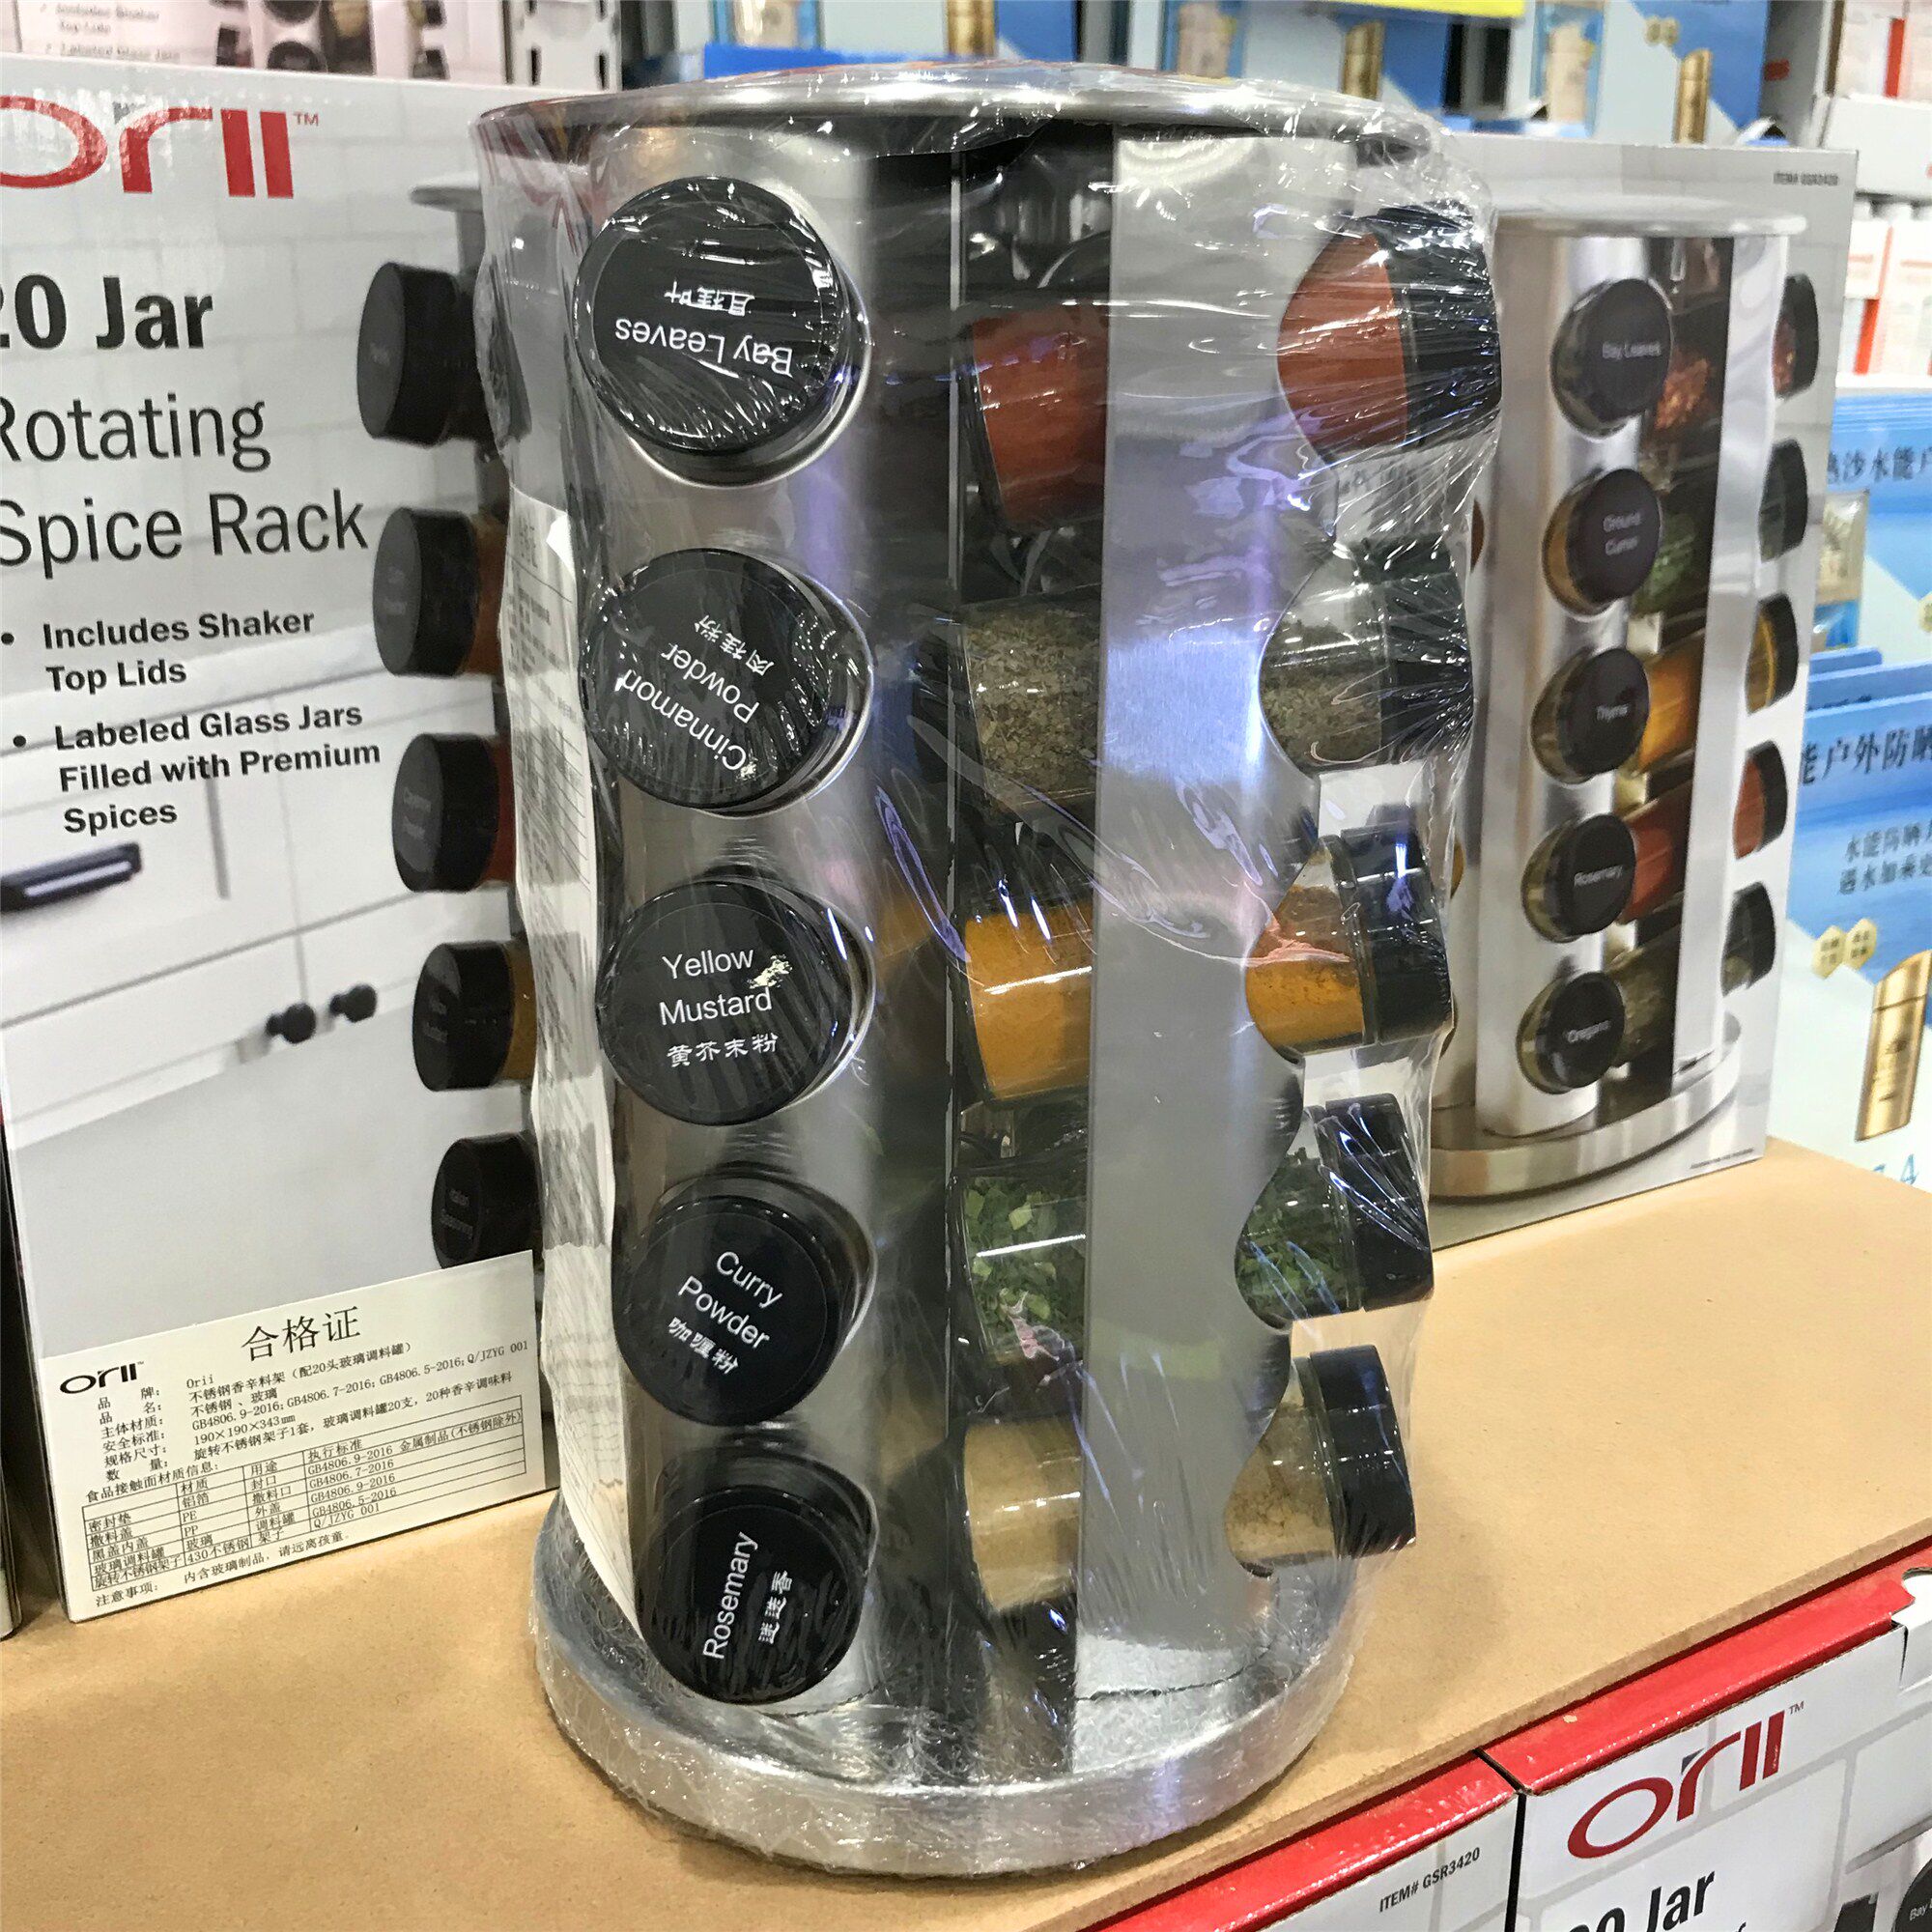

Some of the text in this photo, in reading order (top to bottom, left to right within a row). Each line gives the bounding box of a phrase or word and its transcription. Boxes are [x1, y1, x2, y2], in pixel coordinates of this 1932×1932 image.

[0, 272, 213, 350] 0 Jar
[614, 318, 794, 378] Bay Leaves
[0, 489, 369, 580] Spice Rack
[43, 611, 315, 649] Includes Shaker
[694, 614, 775, 676] 肉桂粉
[46, 659, 188, 694] Top Lids
[661, 642, 760, 724] Powder
[55, 703, 364, 752] Labeled Glass Jars
[614, 668, 748, 771] Cinnamon
[59, 741, 382, 793] Filled with Premium
[64, 803, 179, 838] Spices
[662, 949, 754, 980] Yellow
[659, 986, 773, 1026] Mustard
[667, 1032, 779, 1068] 黄芥末粉
[716, 1251, 783, 1308] Curry
[241, 1305, 361, 1362] 合格证
[677, 1275, 770, 1349] Powder
[510, 1341, 528, 1353] 001
[668, 1317, 739, 1375] 咖喱粉
[186, 1374, 214, 1389] Orii
[181, 1438, 363, 1494] 材质 用途 执行标准
[88, 1512, 131, 1533] 密封垫
[182, 1492, 210, 1508] 铝箔
[251, 1475, 277, 1491] 封口
[92, 1536, 149, 1561] 黑盖内盖
[185, 1524, 199, 1537] PP
[255, 1502, 281, 1518] 外盖
[183, 1510, 197, 1523] PE
[258, 1527, 285, 1544] 架子
[360, 1502, 380, 1516] 001
[95, 1547, 165, 1575] 玻璃调料罐
[186, 1533, 213, 1551] 玻璃
[256, 1512, 296, 1531] 调料罐
[701, 1531, 759, 1660] Rosemary
[757, 1570, 793, 1644] 迷迭香
[1379, 1847, 1481, 1913] ITEM# GSR3420
[1646, 1870, 1716, 1932] Jar
[1909, 1903, 1928, 1921] Bay
